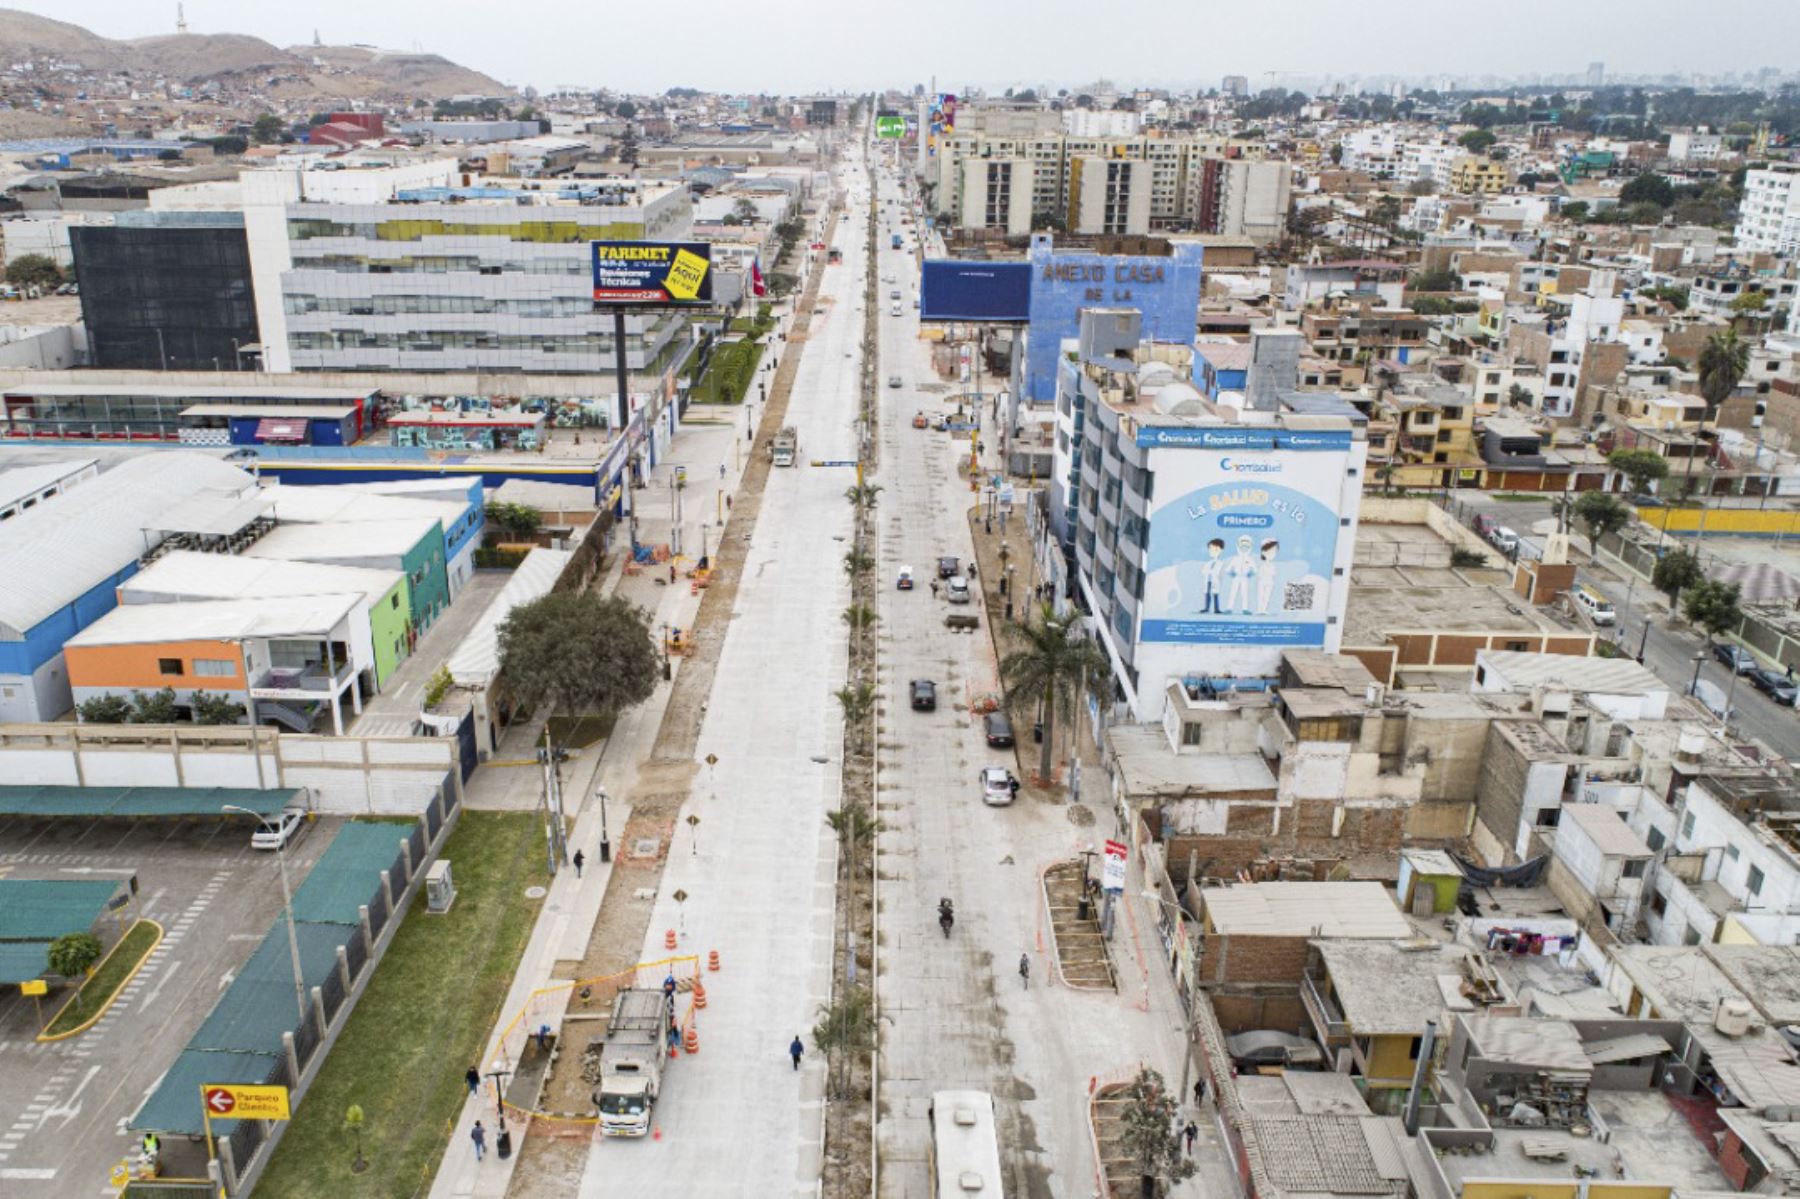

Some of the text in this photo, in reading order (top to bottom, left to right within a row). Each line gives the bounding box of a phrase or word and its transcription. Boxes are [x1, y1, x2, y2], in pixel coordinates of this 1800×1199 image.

[599, 246, 670, 260] FARENET
[600, 267, 651, 278] Revisiones
[1042, 264, 1165, 283] ANEXO CASA
[1084, 288, 1132, 301] DE LA
[1209, 489, 1269, 511] SALUD
[1223, 516, 1267, 526] PRIMERO
[236, 1091, 280, 1102] Parqueo
